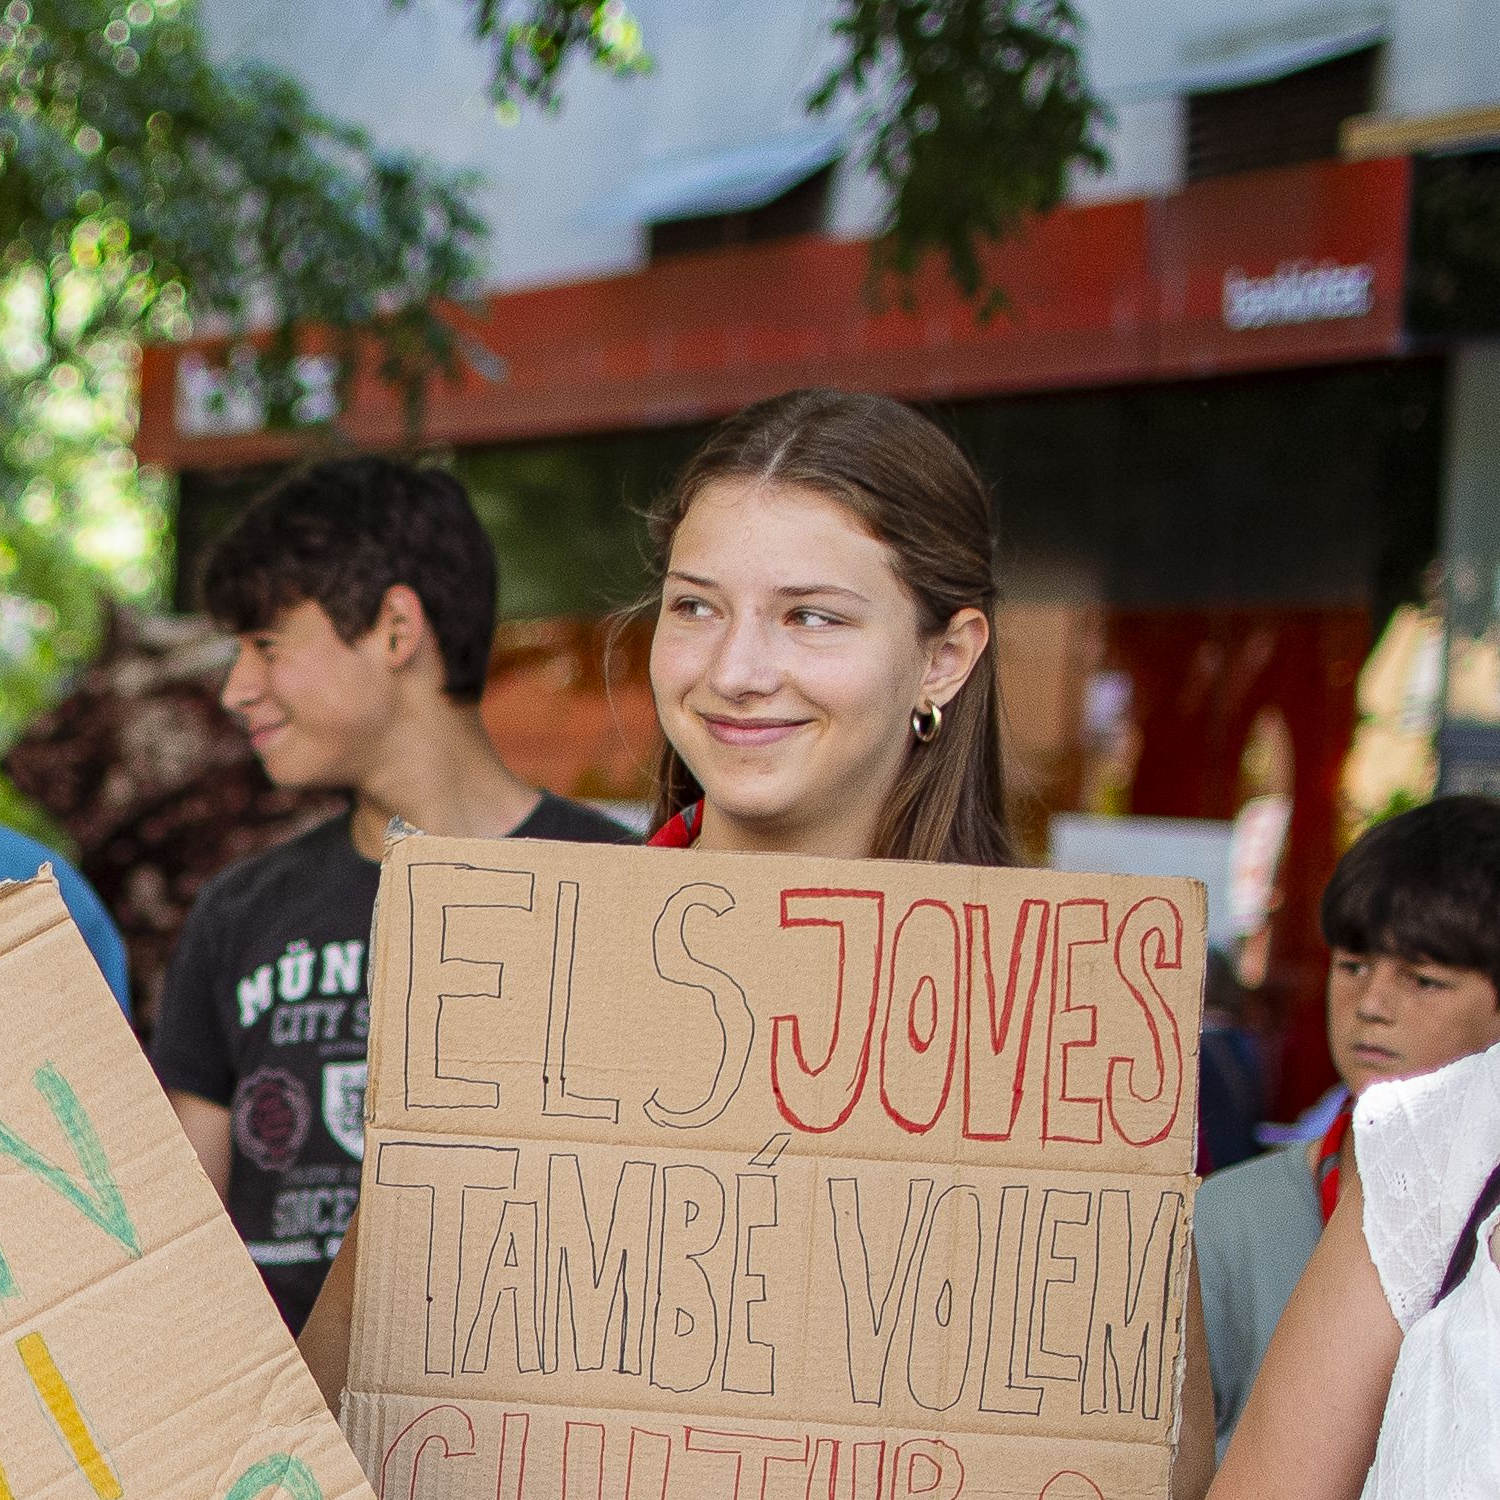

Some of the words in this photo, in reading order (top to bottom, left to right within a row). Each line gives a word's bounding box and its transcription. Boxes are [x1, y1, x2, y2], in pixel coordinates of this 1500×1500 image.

[270, 1001, 348, 1047] CITY
[405, 862, 755, 1129] ELS
[769, 888, 1184, 1149] JOVES
[376, 1132, 792, 1395] TAMBÉ
[828, 1177, 1186, 1421] VOLEM
